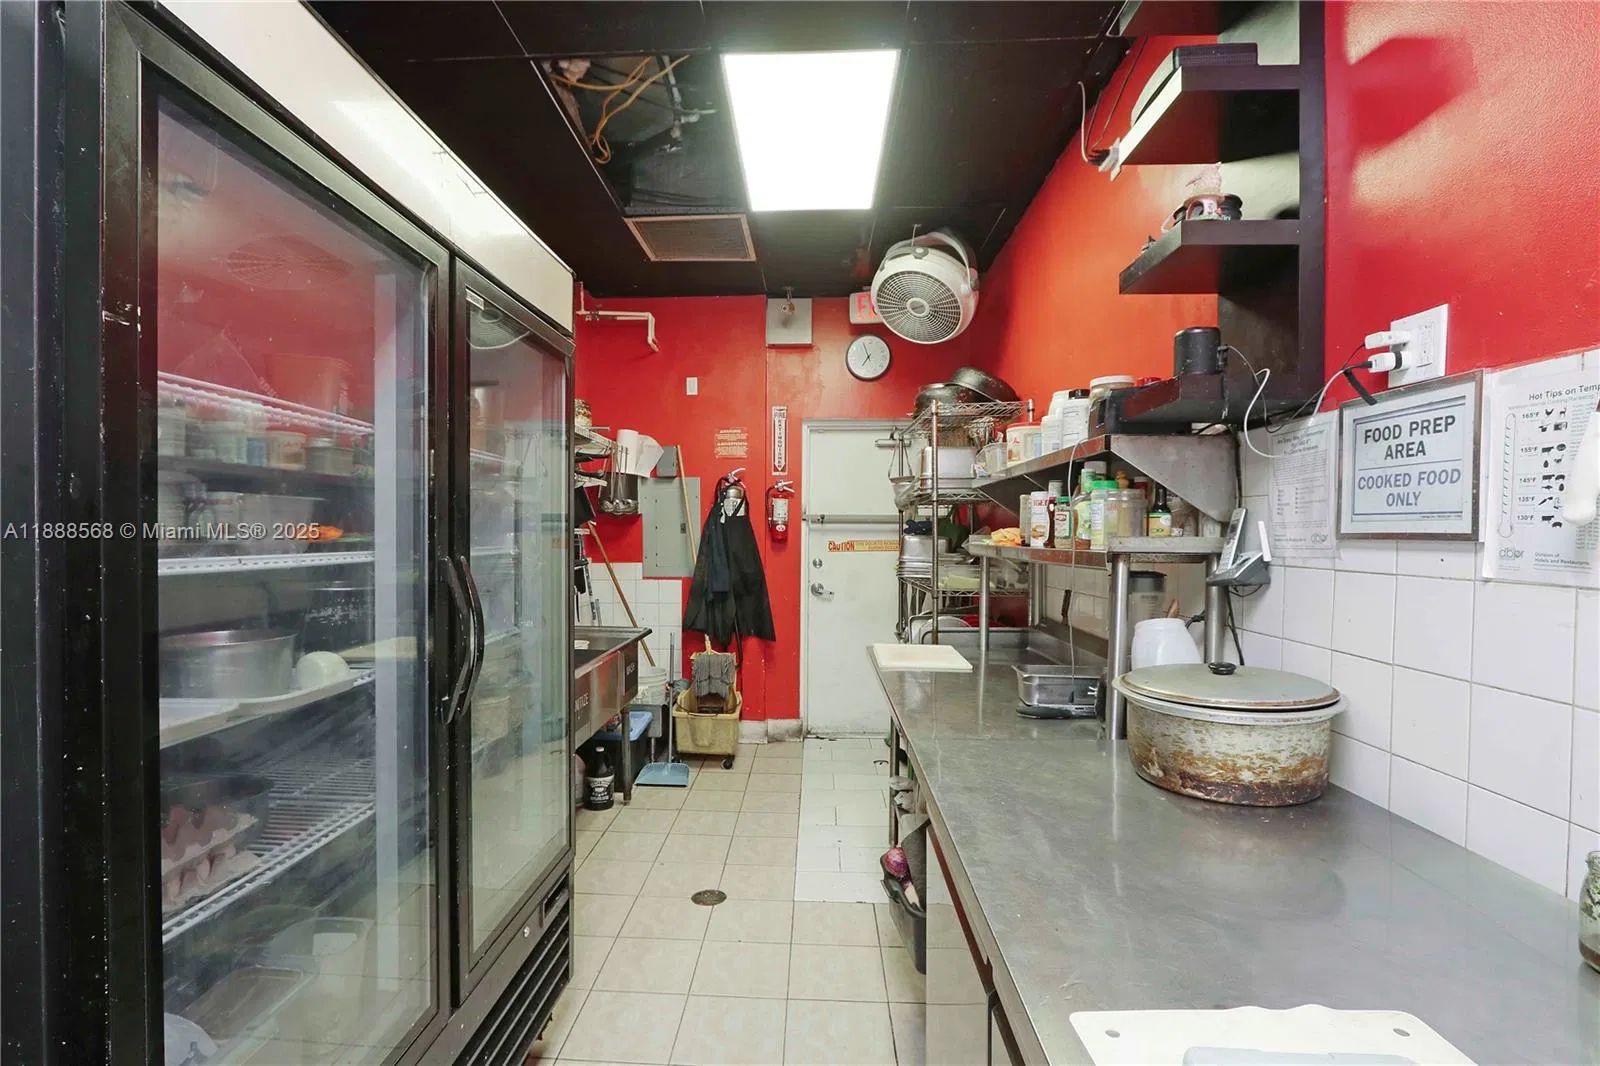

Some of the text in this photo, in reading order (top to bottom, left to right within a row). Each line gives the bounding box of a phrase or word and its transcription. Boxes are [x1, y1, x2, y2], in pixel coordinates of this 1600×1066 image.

[1528, 393, 1543, 401] Hot
[1545, 390, 1562, 399] Tips
[1565, 387, 1576, 395] on
[1363, 414, 1456, 445] FOOD PREP
[1384, 440, 1426, 461] AREA
[1357, 468, 1461, 490] COOKED FOOD
[1386, 491, 1422, 507] ONLY
[828, 541, 855, 551] CAUTION
